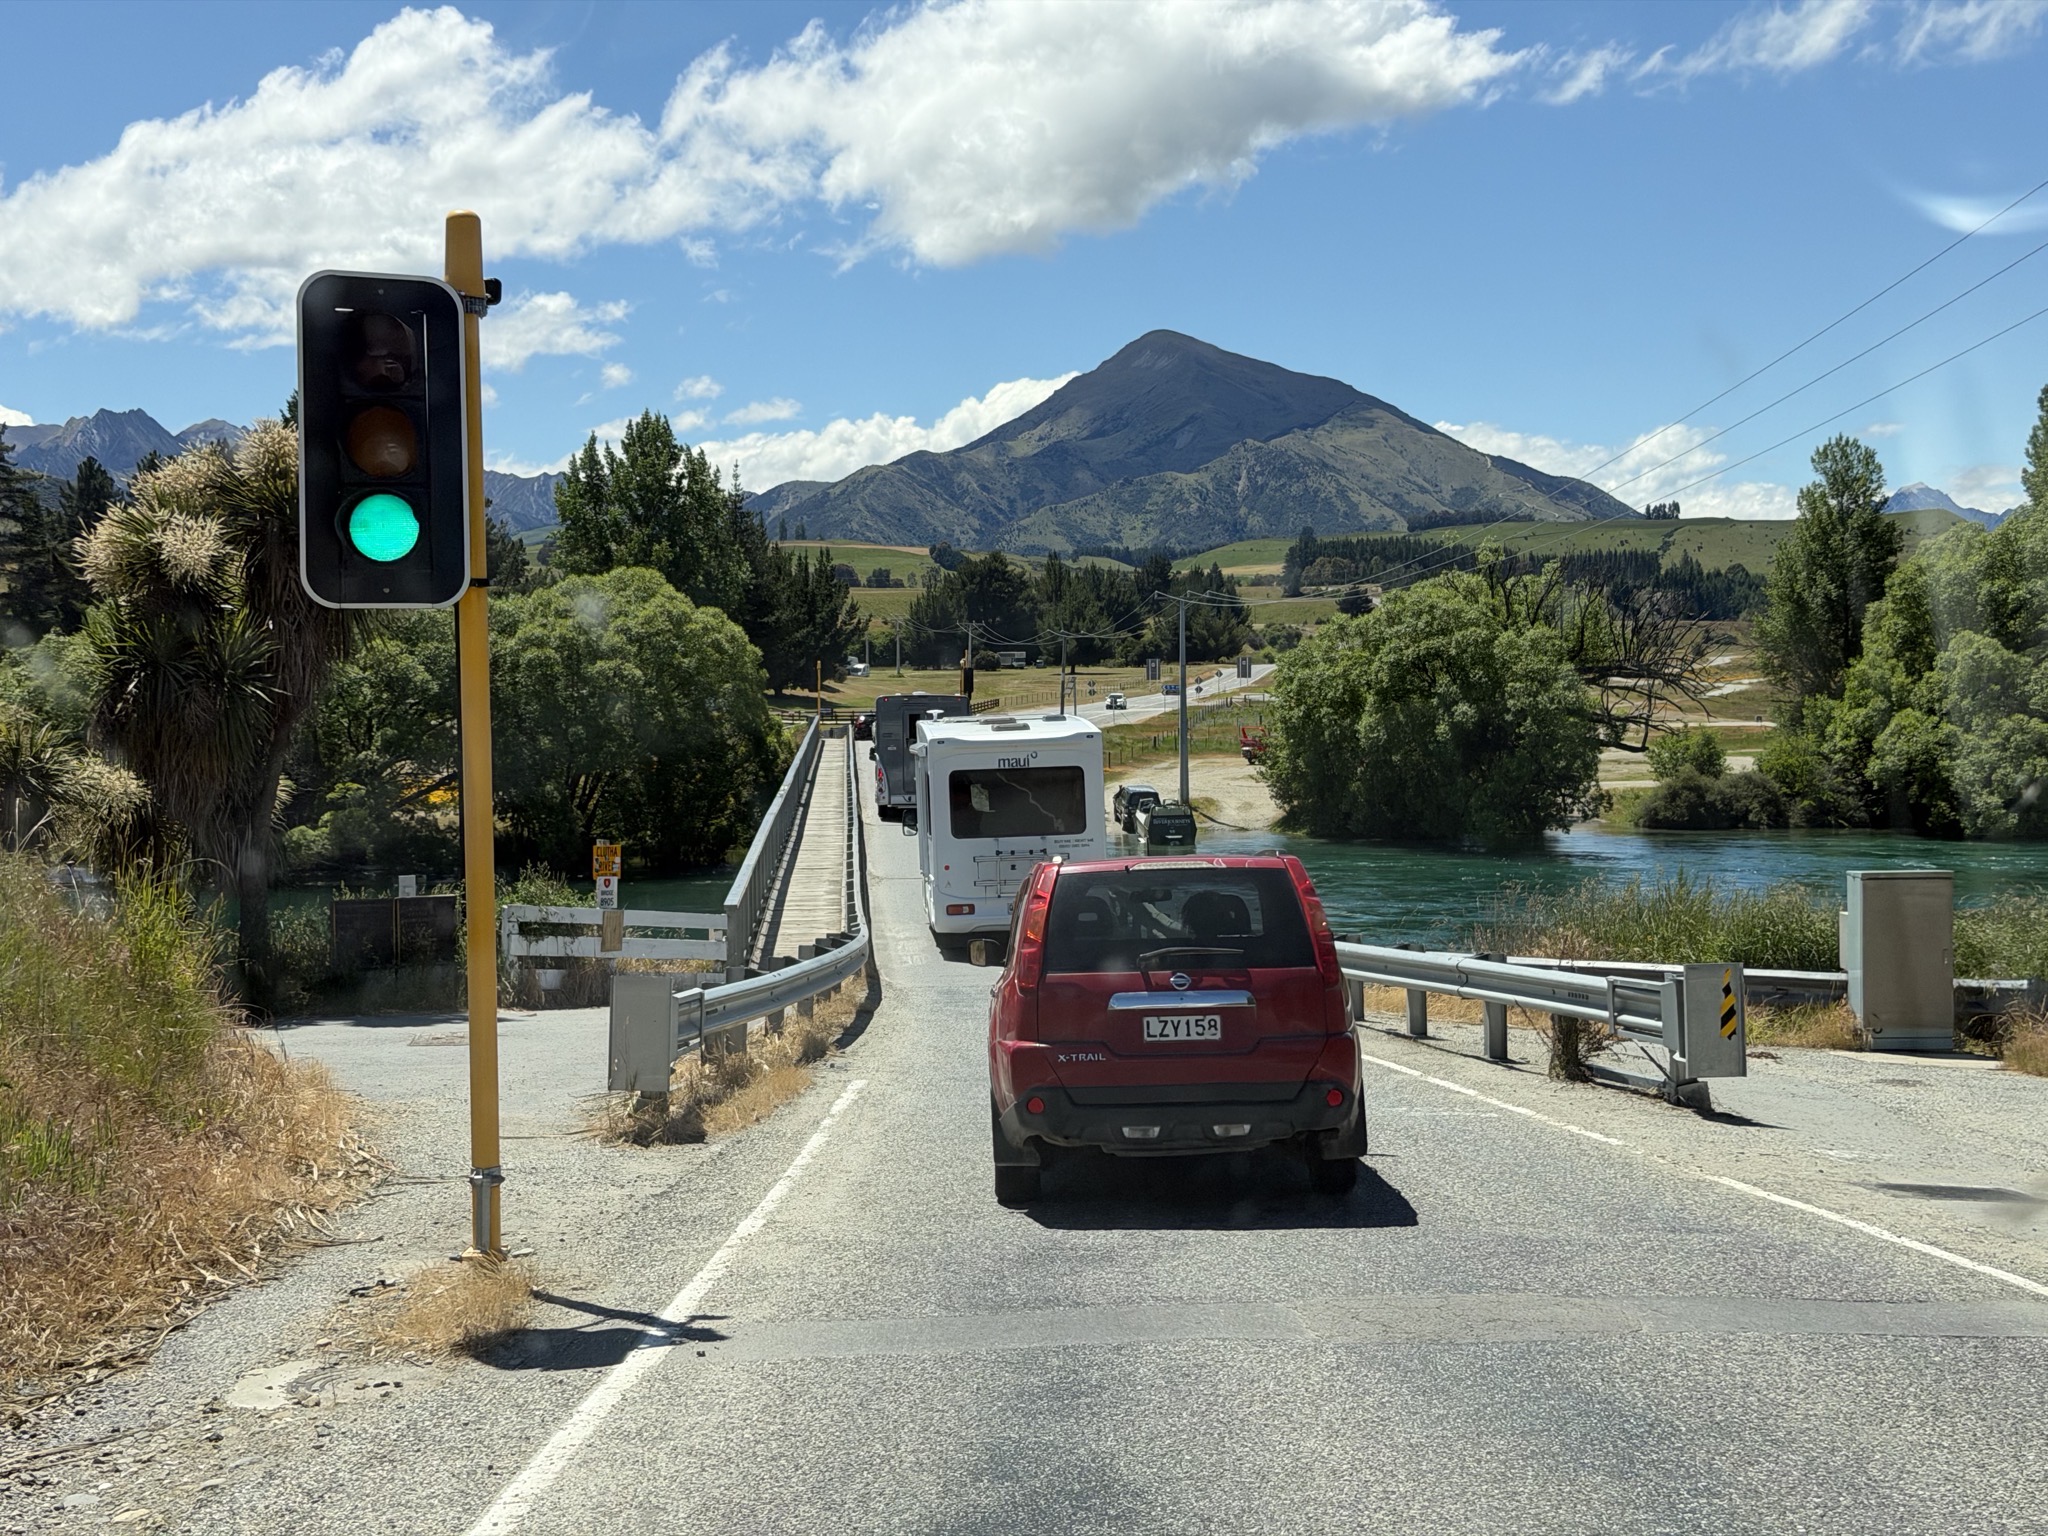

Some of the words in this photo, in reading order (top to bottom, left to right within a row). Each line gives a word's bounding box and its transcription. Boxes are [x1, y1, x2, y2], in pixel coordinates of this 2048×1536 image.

[997, 754, 1030, 769] maui
[596, 846, 618, 857] CLUTHA
[1146, 1017, 1219, 1039] LZY158
[1058, 1053, 1106, 1063] X-TRAIL
